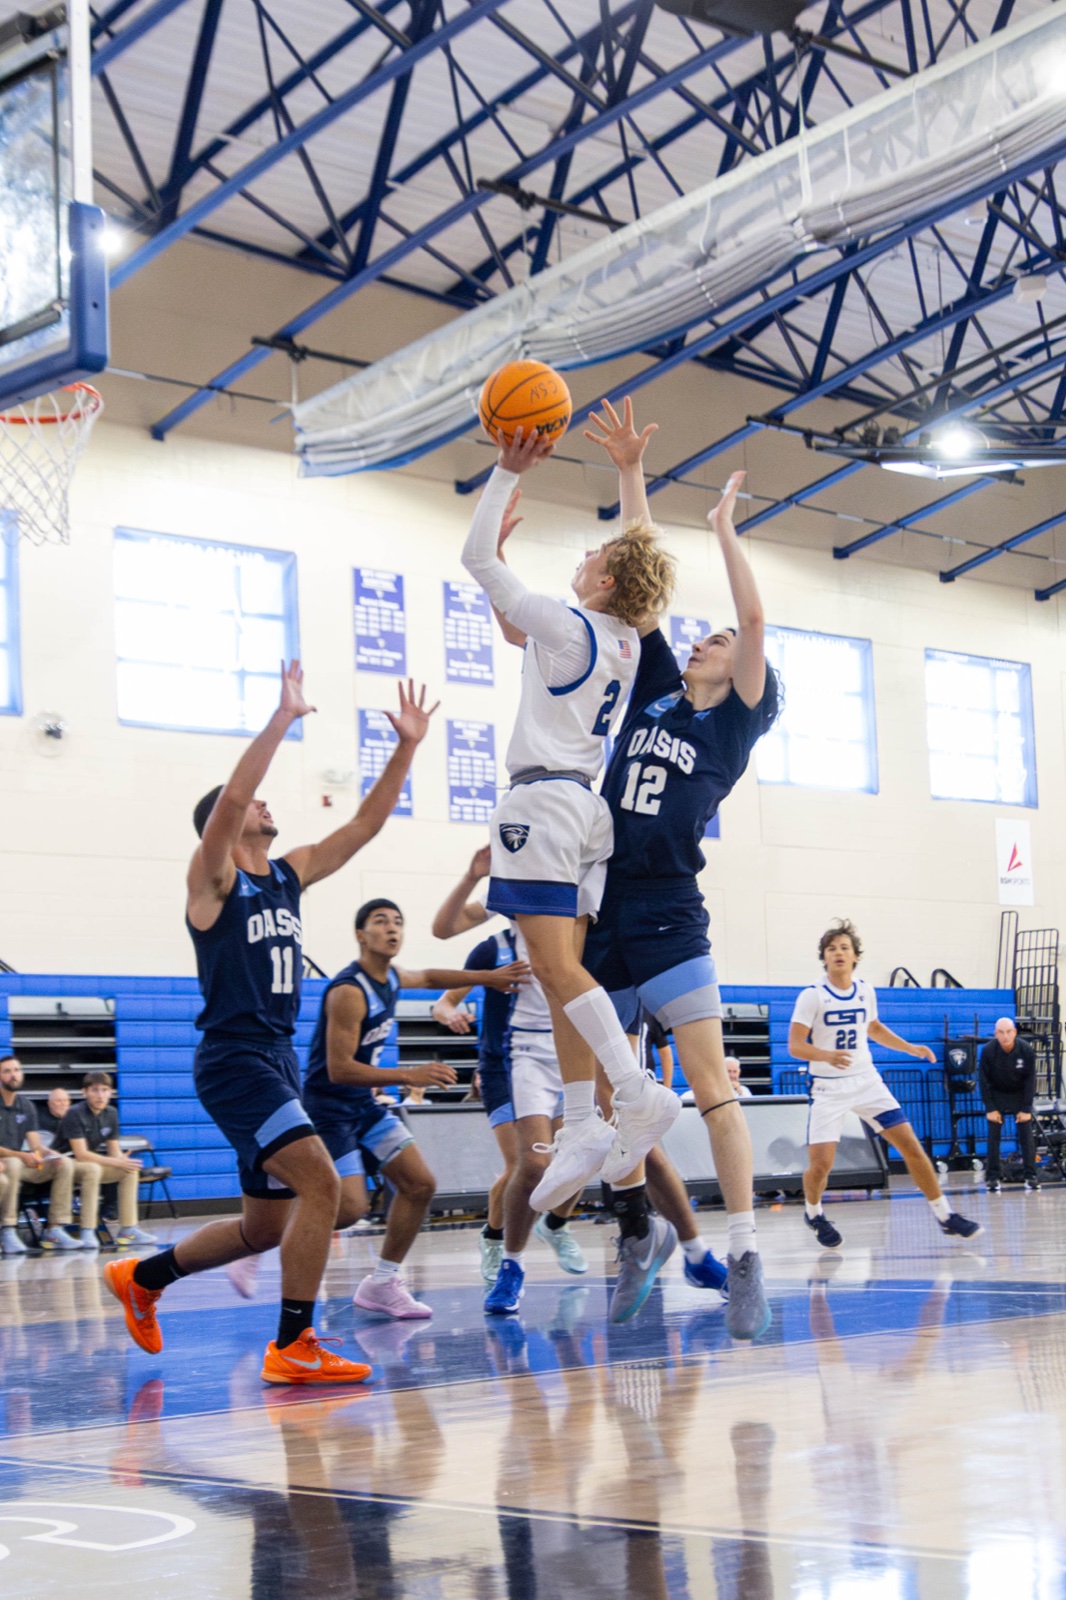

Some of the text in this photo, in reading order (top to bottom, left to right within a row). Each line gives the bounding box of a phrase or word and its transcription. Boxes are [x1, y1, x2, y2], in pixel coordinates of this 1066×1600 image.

[591, 679, 622, 737] 2
[626, 725, 697, 775] OASIS
[620, 761, 668, 816] 12
[270, 946, 294, 994] 11
[823, 1007, 867, 1027] CSN
[835, 1029, 857, 1050] 22
